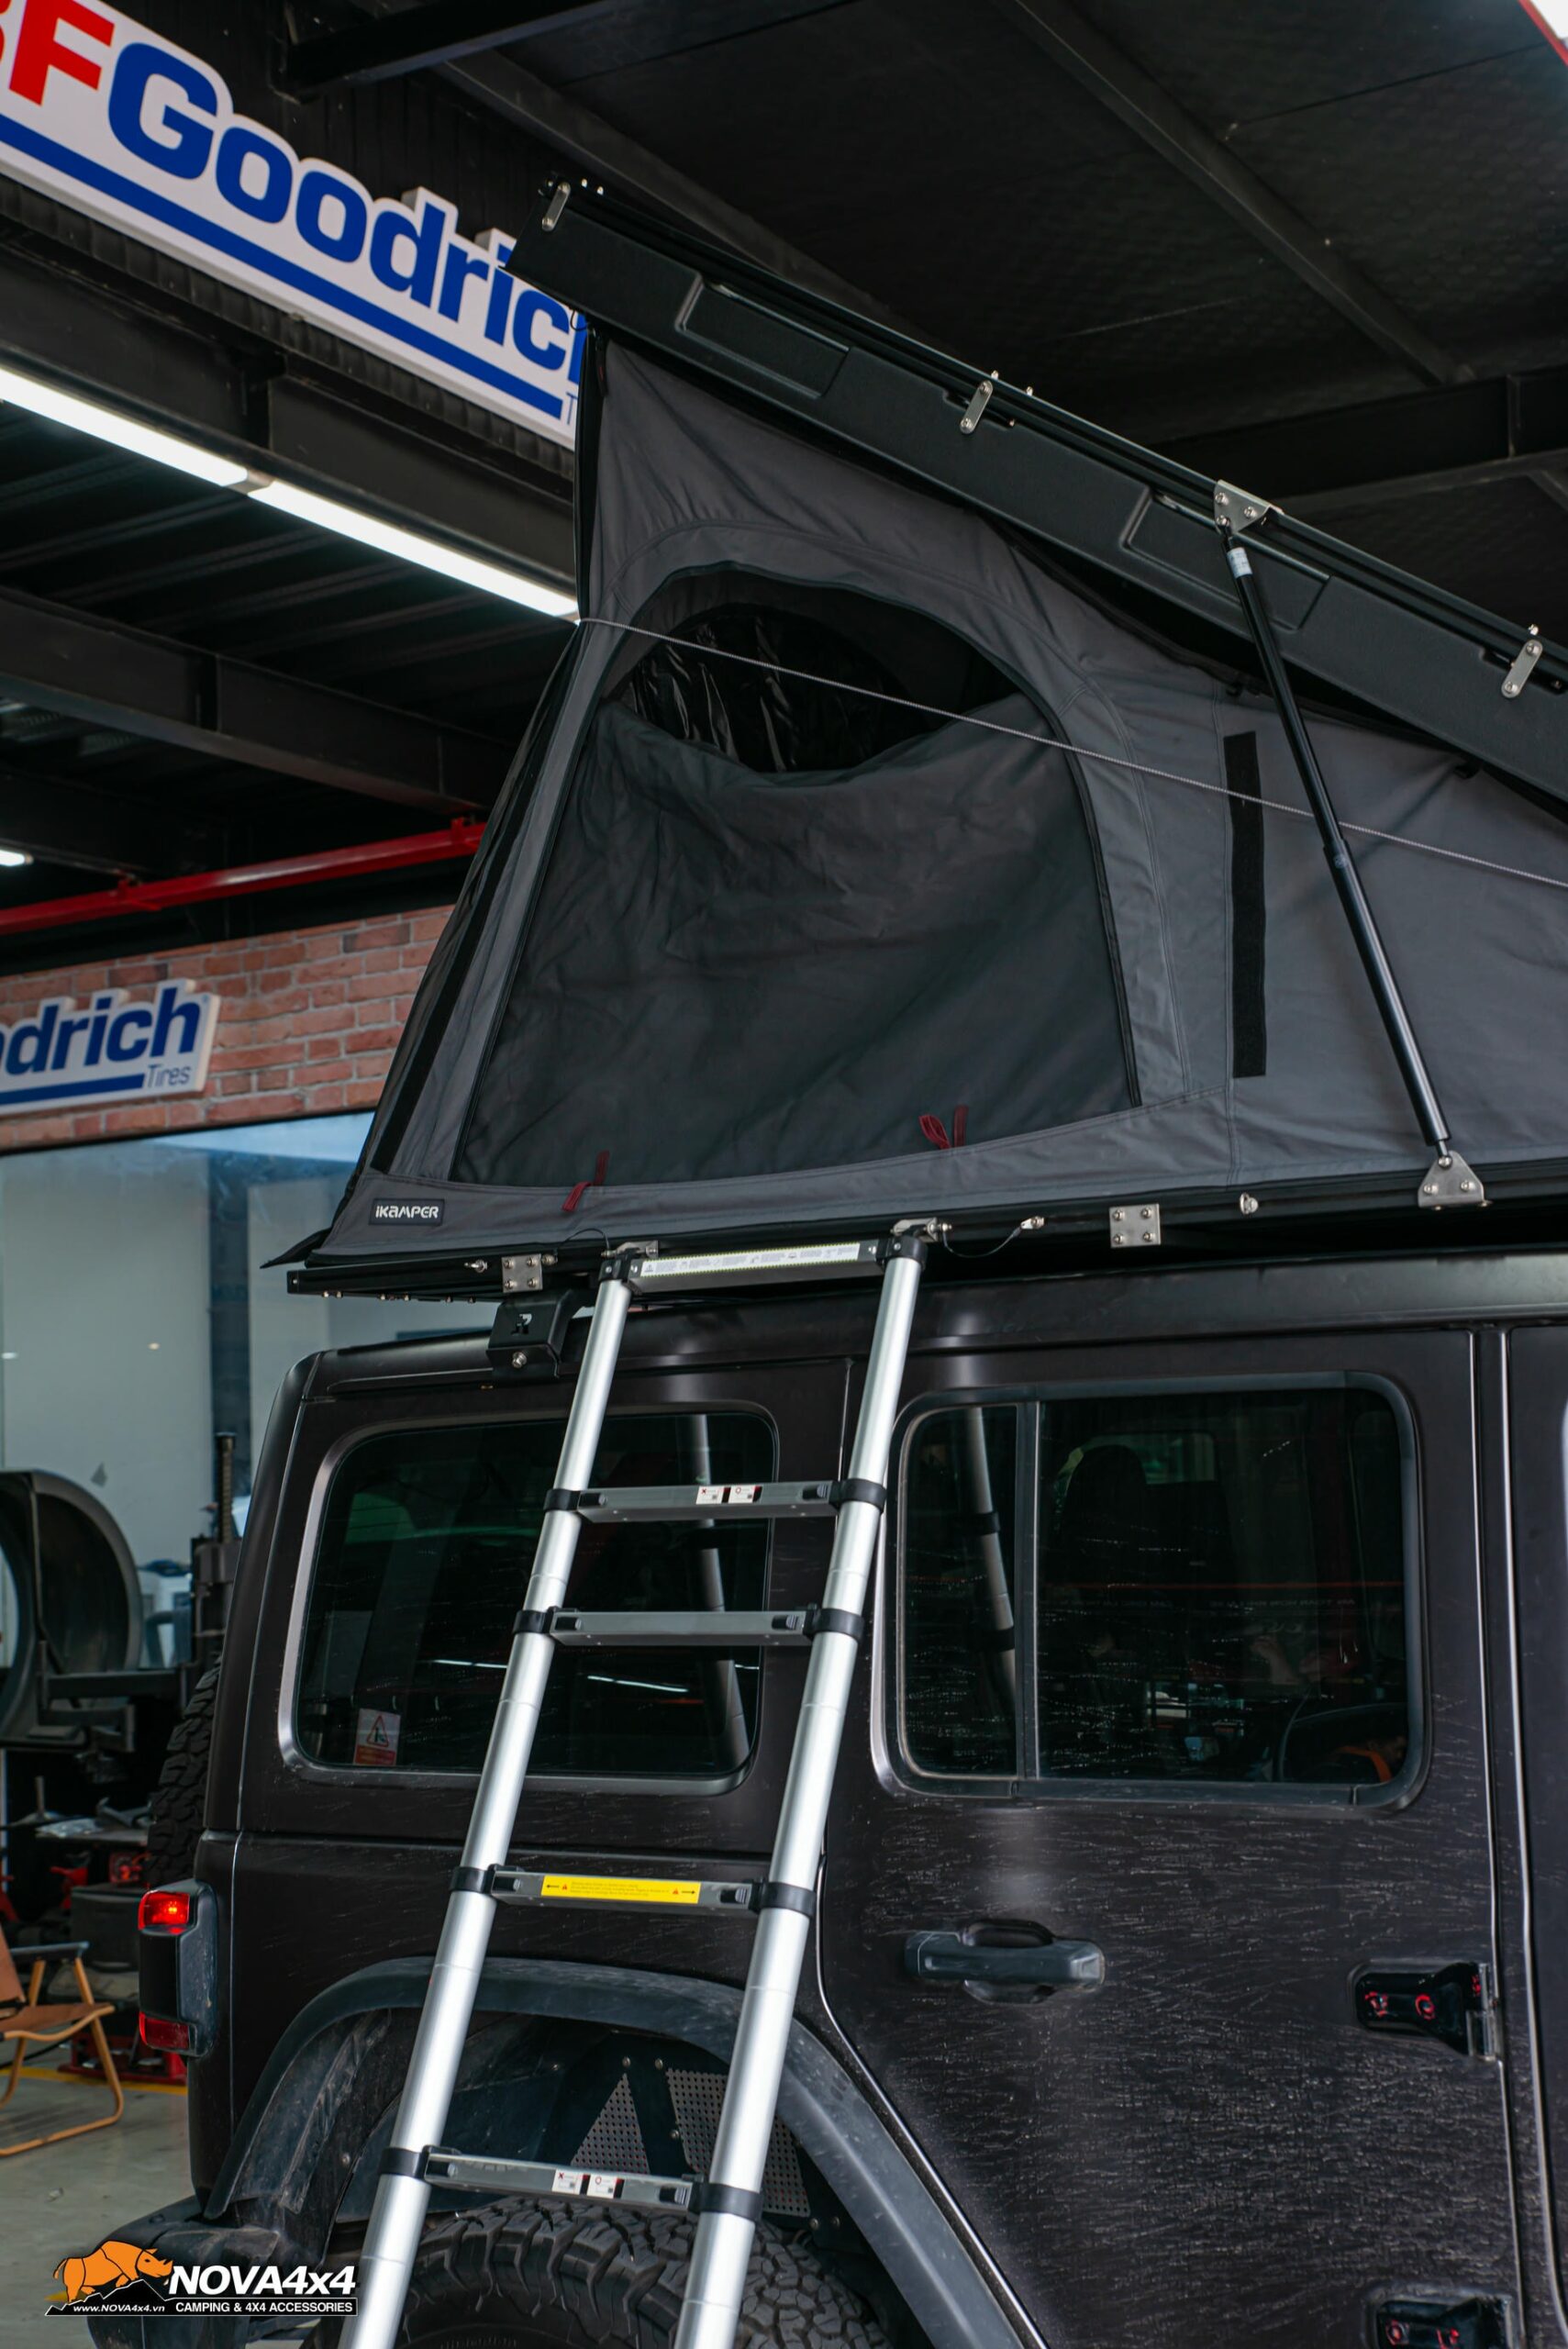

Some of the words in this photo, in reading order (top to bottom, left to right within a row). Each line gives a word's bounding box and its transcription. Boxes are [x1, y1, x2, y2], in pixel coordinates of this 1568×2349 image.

[0, 0, 587, 385] FGoodric
[0, 987, 201, 1075] drich
[148, 1063, 192, 1088] Tires
